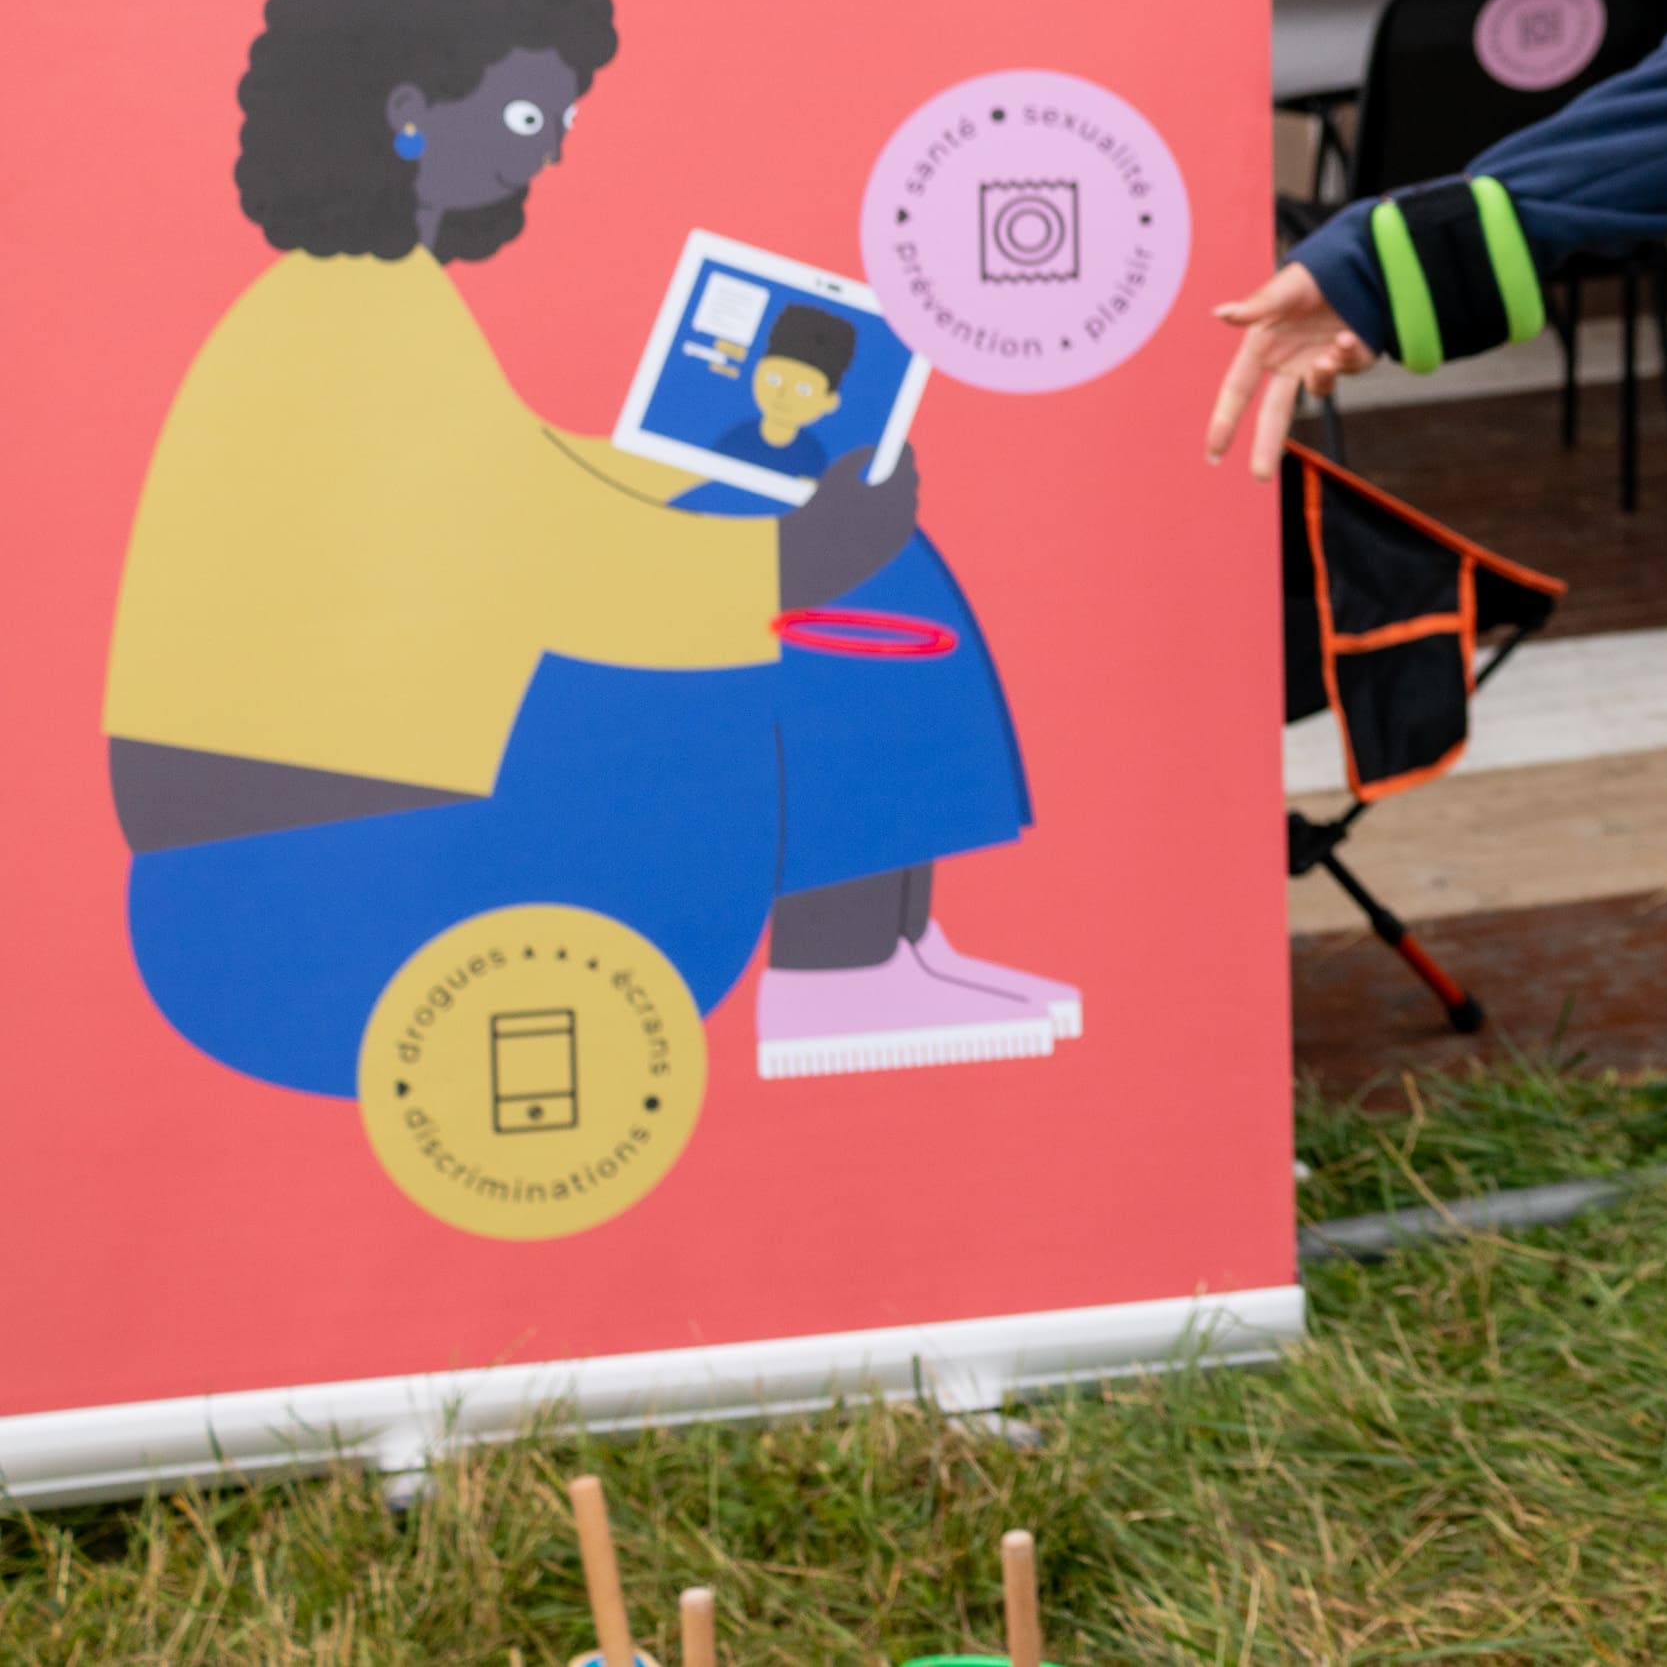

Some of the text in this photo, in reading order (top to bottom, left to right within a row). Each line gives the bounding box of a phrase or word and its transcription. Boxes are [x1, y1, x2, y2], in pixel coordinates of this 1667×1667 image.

[904, 114, 978, 198] santé
[1023, 104, 1153, 200] sexualité
[893, 240, 1044, 359] prévention
[1084, 244, 1155, 344] plaisir
[399, 944, 509, 1066] drogues
[610, 964, 672, 1080] écrans
[403, 1106, 651, 1205] discriminations
